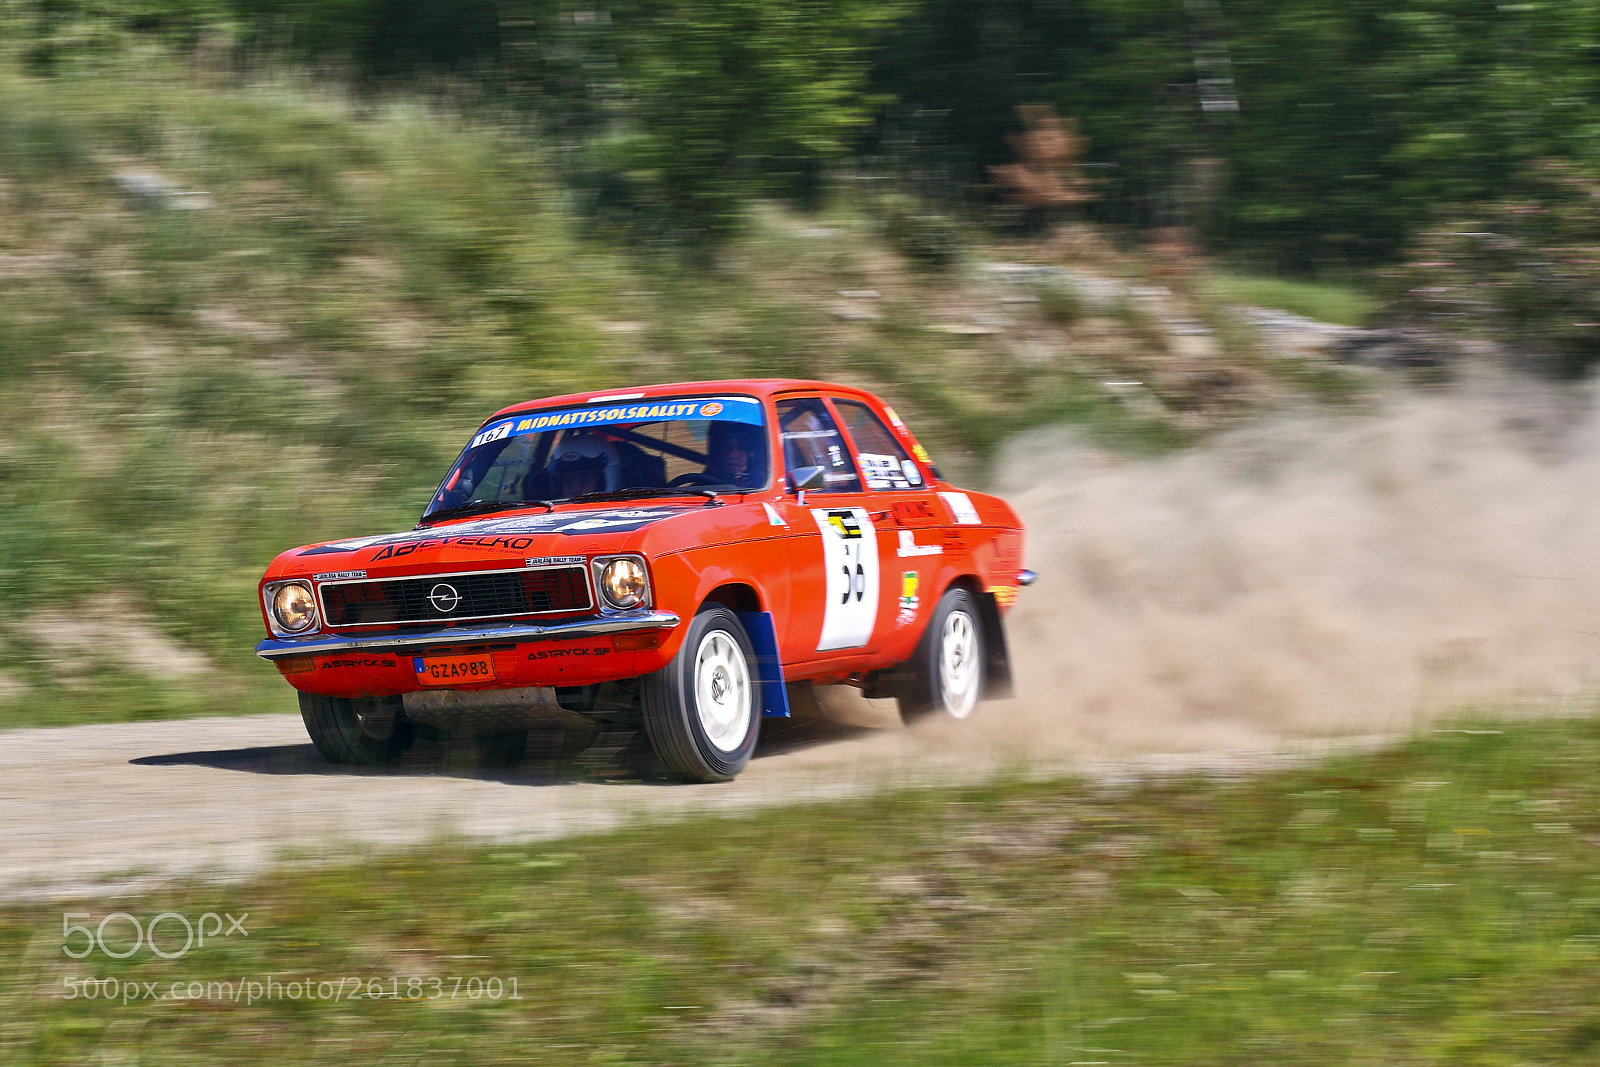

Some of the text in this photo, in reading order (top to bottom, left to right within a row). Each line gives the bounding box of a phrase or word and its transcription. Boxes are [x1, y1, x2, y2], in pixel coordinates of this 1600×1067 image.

[515, 404, 697, 431] MIDNATTSSOLSRALLYT
[478, 426, 504, 445] 167
[322, 659, 397, 669] ASTRYCK.SE
[431, 661, 489, 678] GZA988
